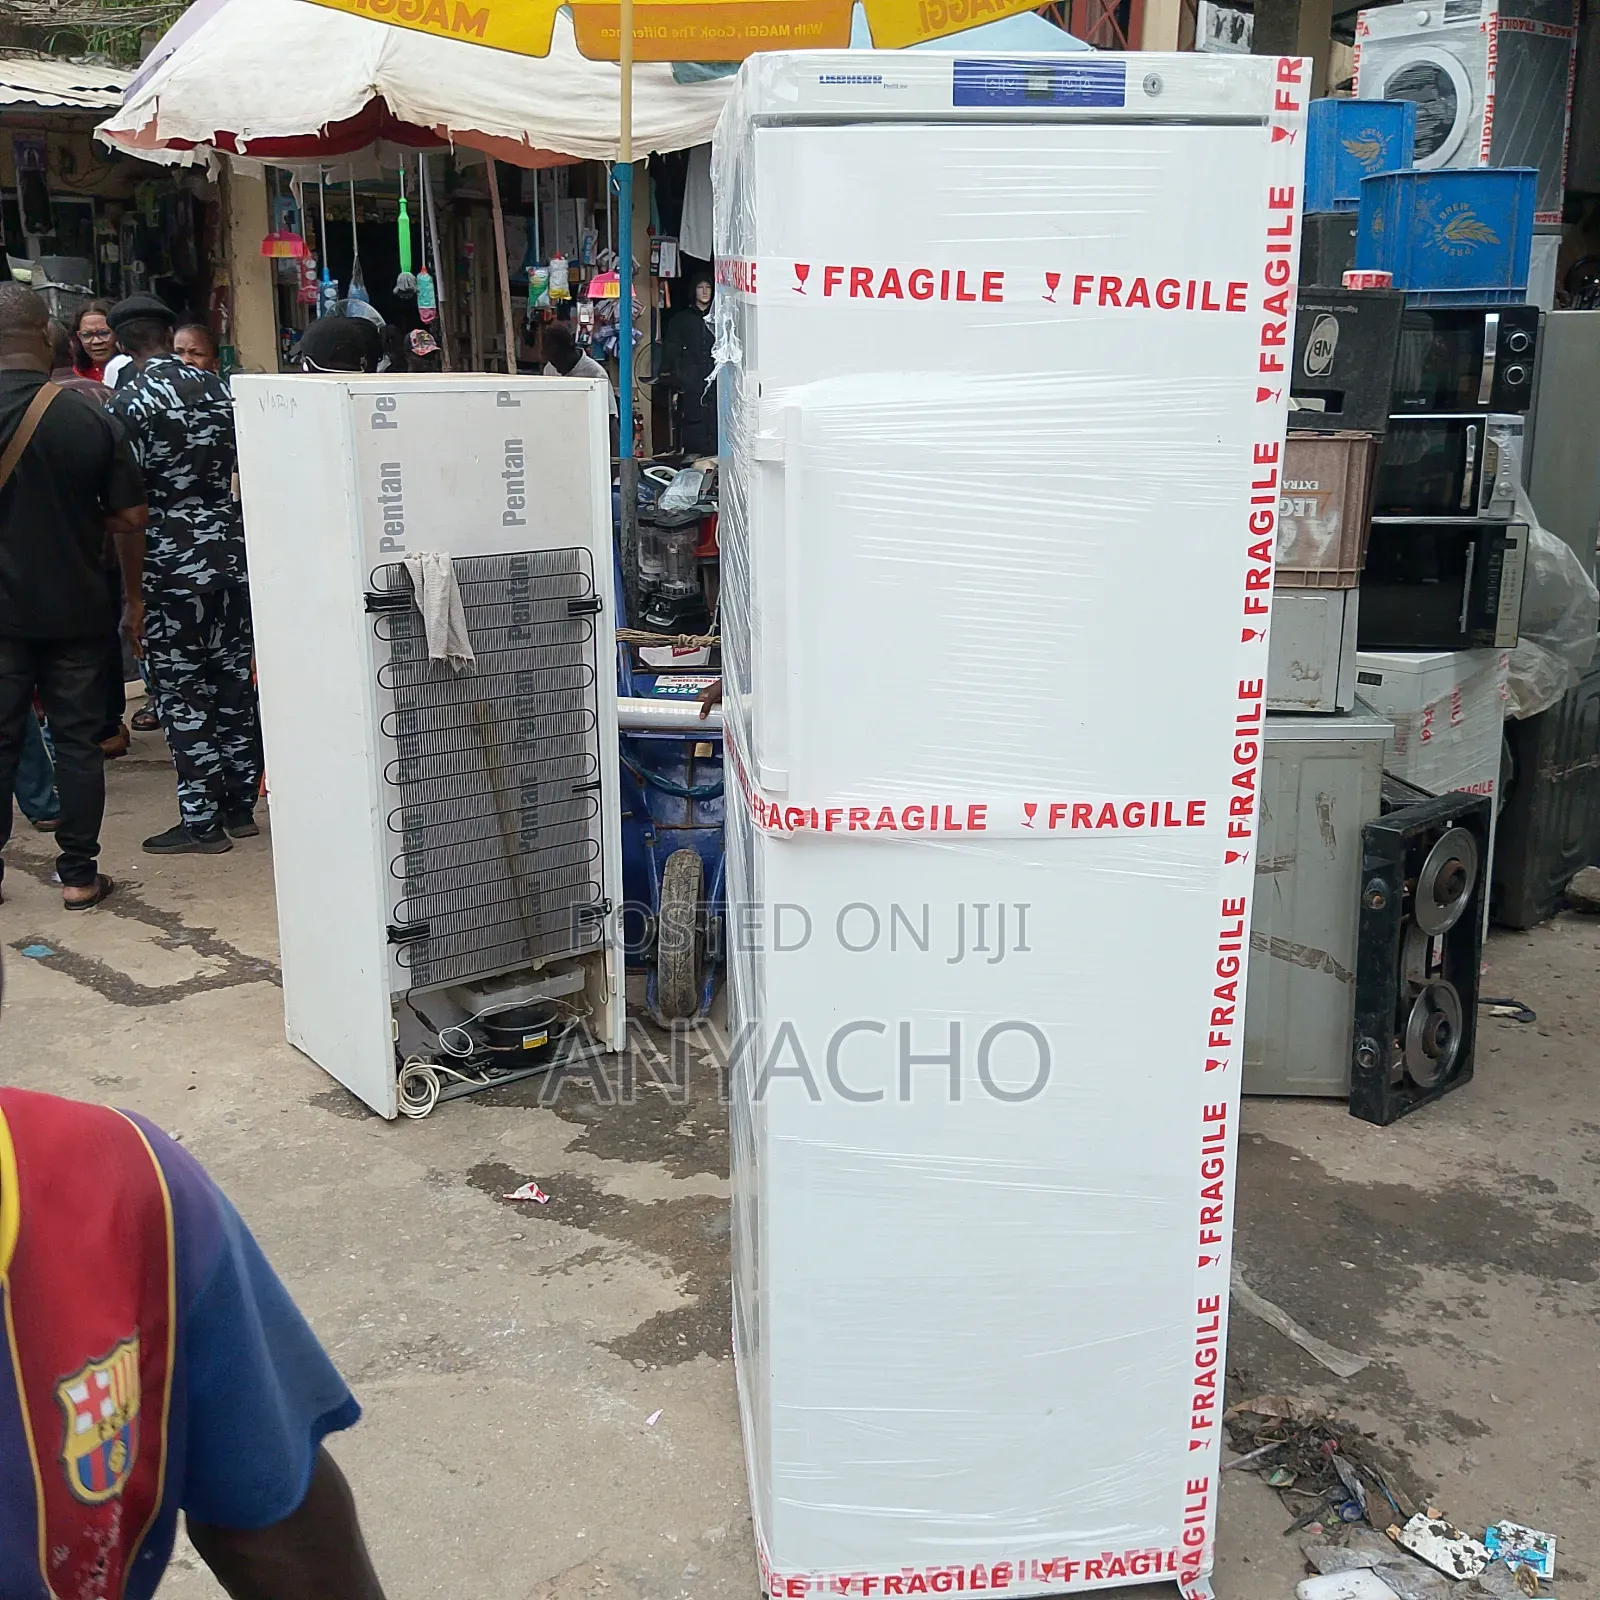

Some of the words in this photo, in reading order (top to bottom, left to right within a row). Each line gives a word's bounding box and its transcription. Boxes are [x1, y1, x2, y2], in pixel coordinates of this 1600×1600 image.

[1487, 11, 1498, 81] FRAGILE
[1479, 94, 1496, 163] FRAGILE
[823, 266, 1005, 303] FRAGILE
[1072, 275, 1248, 312] FRAGILE
[1258, 186, 1295, 373] FRAGILE
[1313, 340, 1332, 358] NB
[371, 396, 398, 430] Pe
[377, 461, 406, 554] Pentan
[500, 438, 527, 527] Pentan
[1282, 480, 1319, 490] EXTRA
[1244, 441, 1280, 616] FRAGILE
[507, 555, 532, 642] Pentan
[1227, 678, 1263, 838] FRAGILE
[825, 804, 988, 831] FRAGILE
[1049, 801, 1206, 829] FRAGILE
[1208, 897, 1246, 1047] FRAGILE
[1198, 1102, 1227, 1245] FRAGILE
[1190, 1295, 1220, 1430] FRAGILE
[862, 1566, 1011, 1597] FRAGILE
[1064, 1552, 1178, 1582] FRAGIL
[1180, 1477, 1209, 1600] FRAGILE
